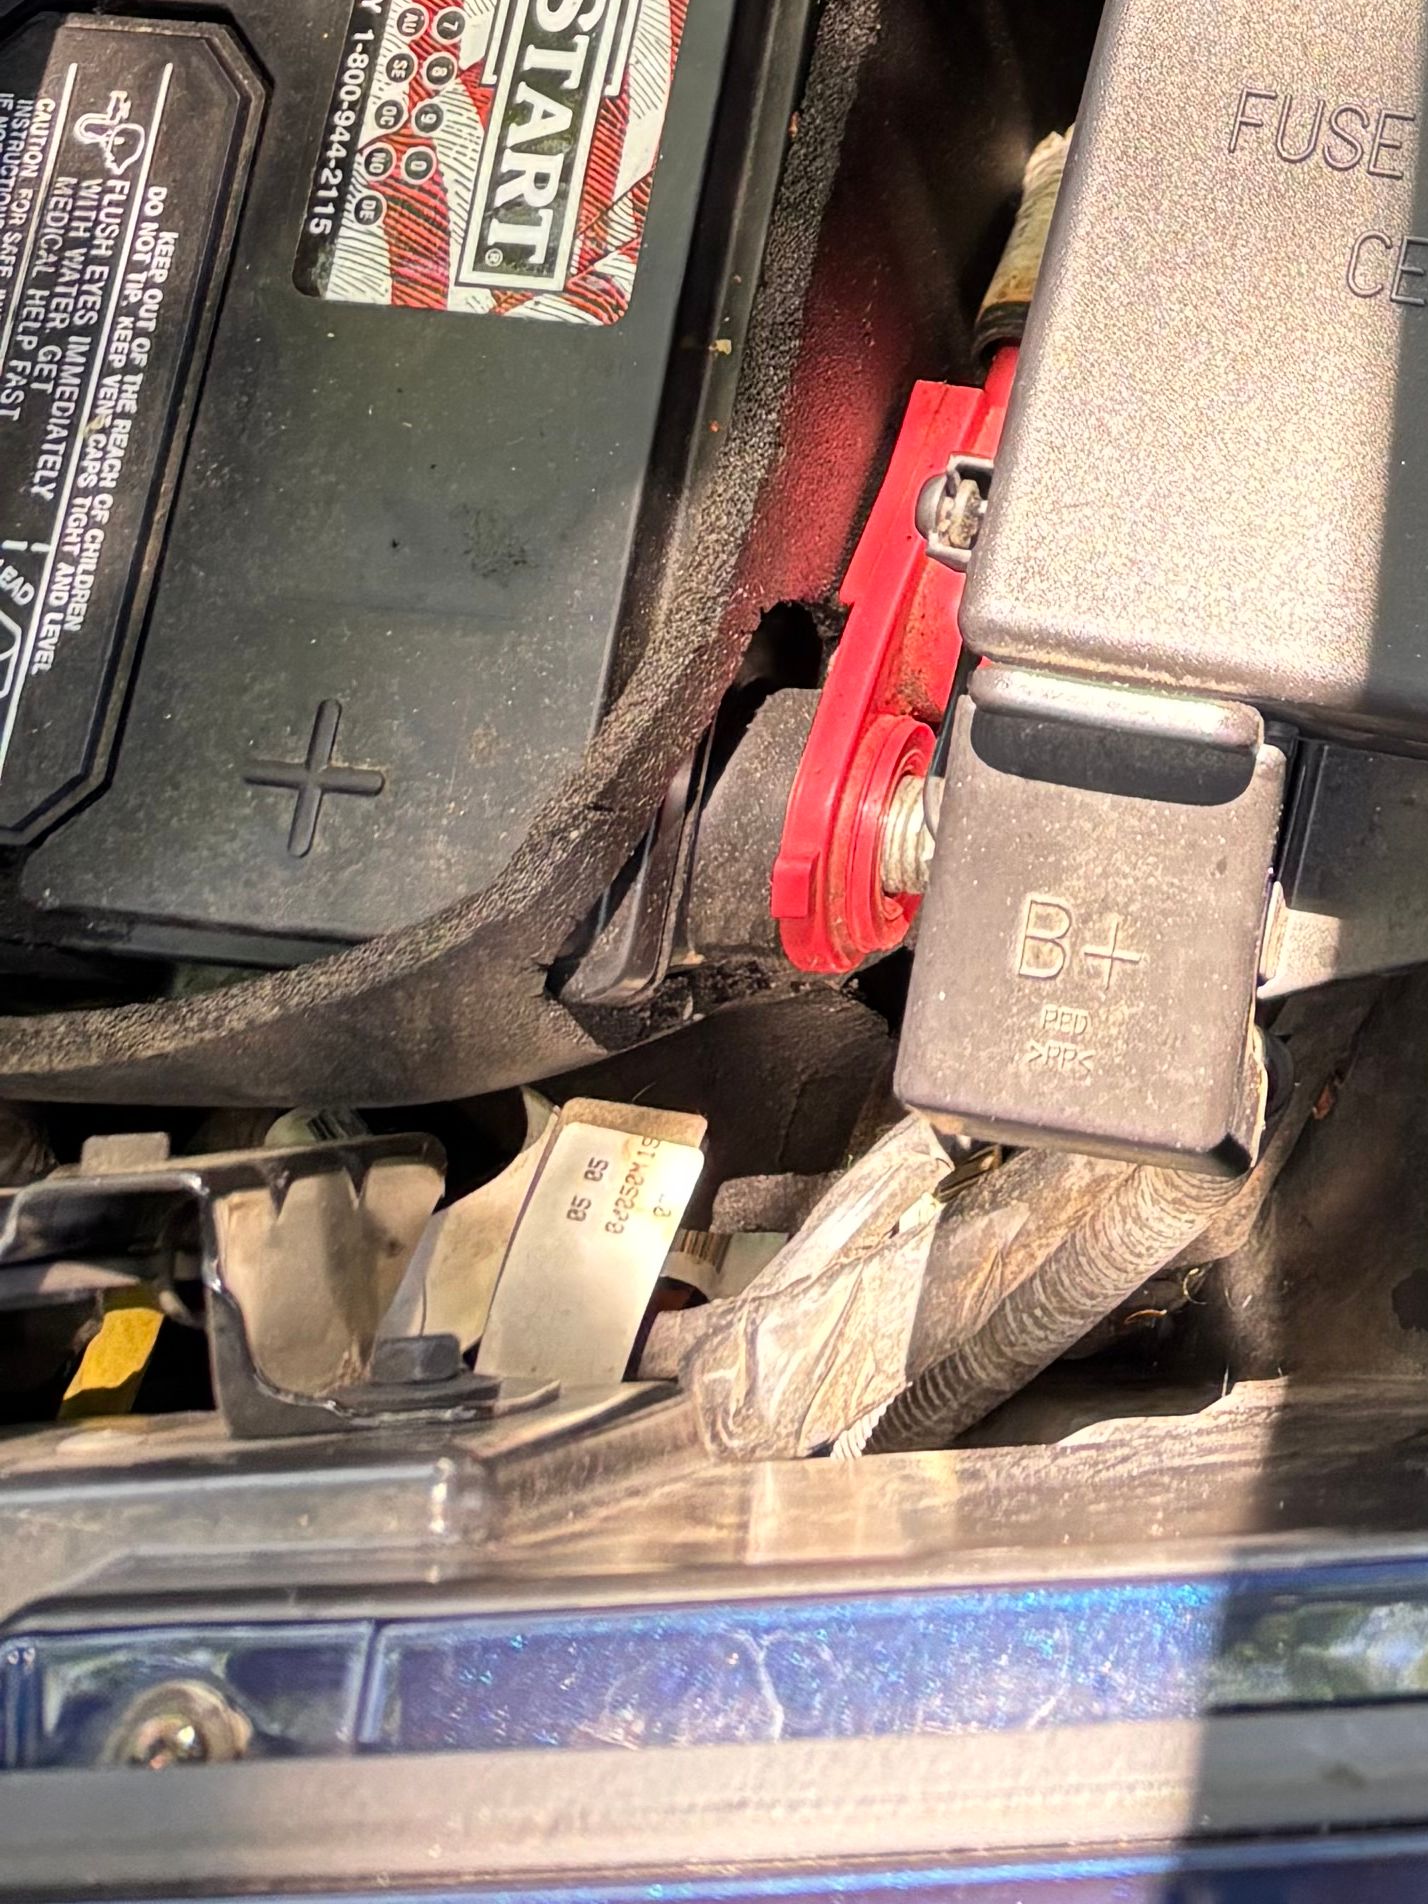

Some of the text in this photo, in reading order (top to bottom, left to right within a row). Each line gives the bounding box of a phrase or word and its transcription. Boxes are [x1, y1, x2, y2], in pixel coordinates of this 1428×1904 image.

[307, 27, 375, 235] 1-800-944-2115
[1227, 87, 1416, 180] FUSE
[0, 175, 78, 422] MEDICAL HELP FAST
[28, 177, 103, 395] WITH WATER. GET
[29, 178, 131, 501] FLUSH EYES IMMEDIATELY
[62, 230, 179, 632] KEEP OUT OF THE REACH OF CHILDREN
